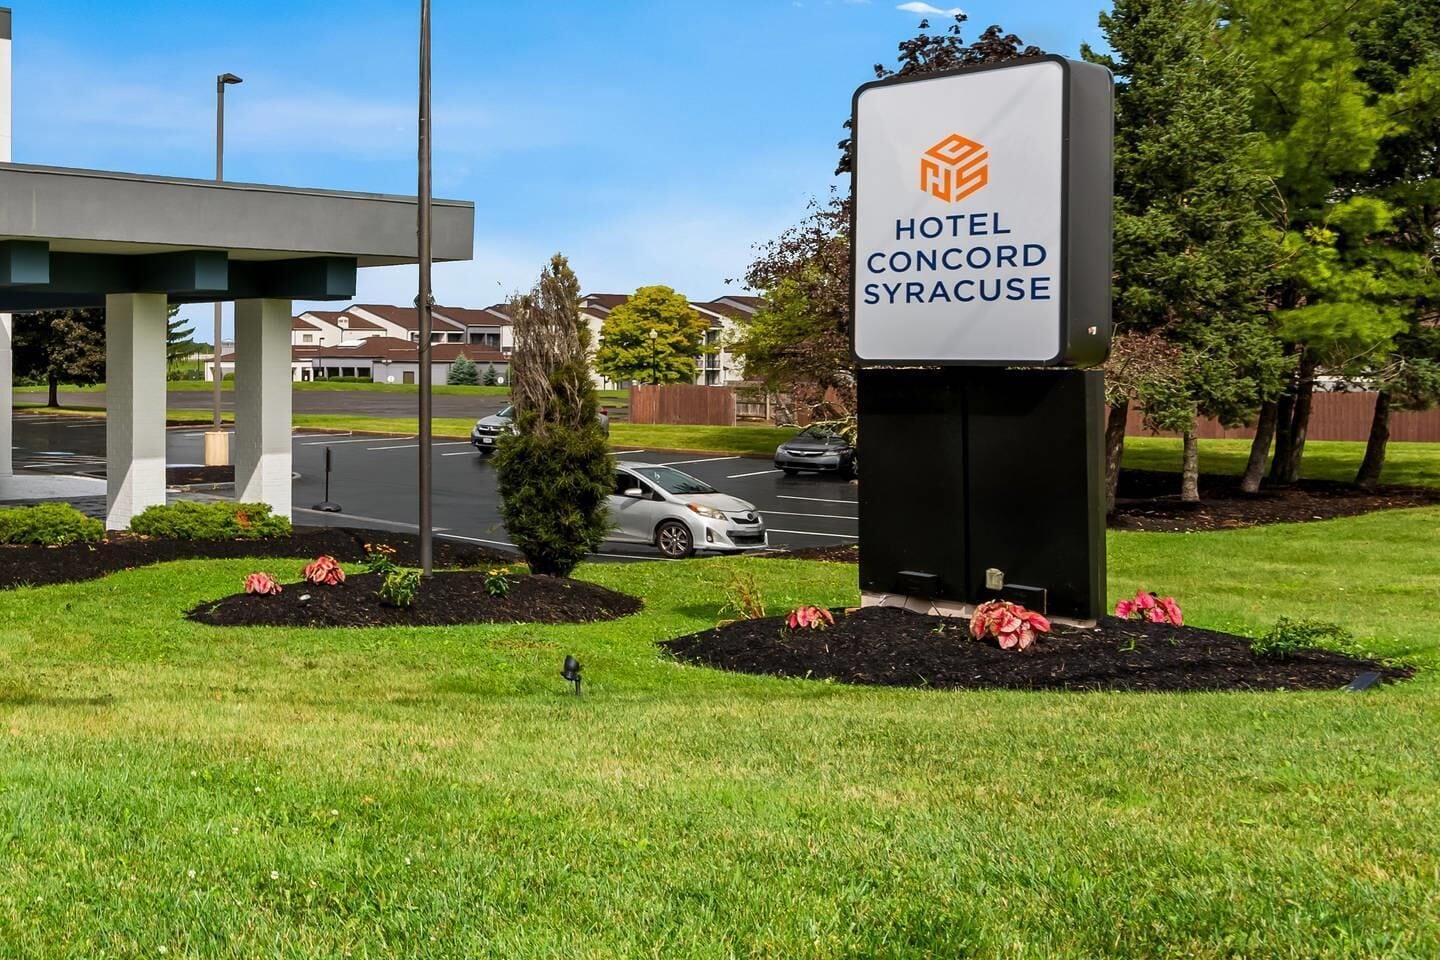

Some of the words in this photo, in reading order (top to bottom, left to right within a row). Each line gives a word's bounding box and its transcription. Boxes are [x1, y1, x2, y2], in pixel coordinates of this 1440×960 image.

[896, 212, 1011, 240] HOTEL
[867, 244, 1047, 274] CONCORD
[863, 277, 1051, 305] SYRACUSE
